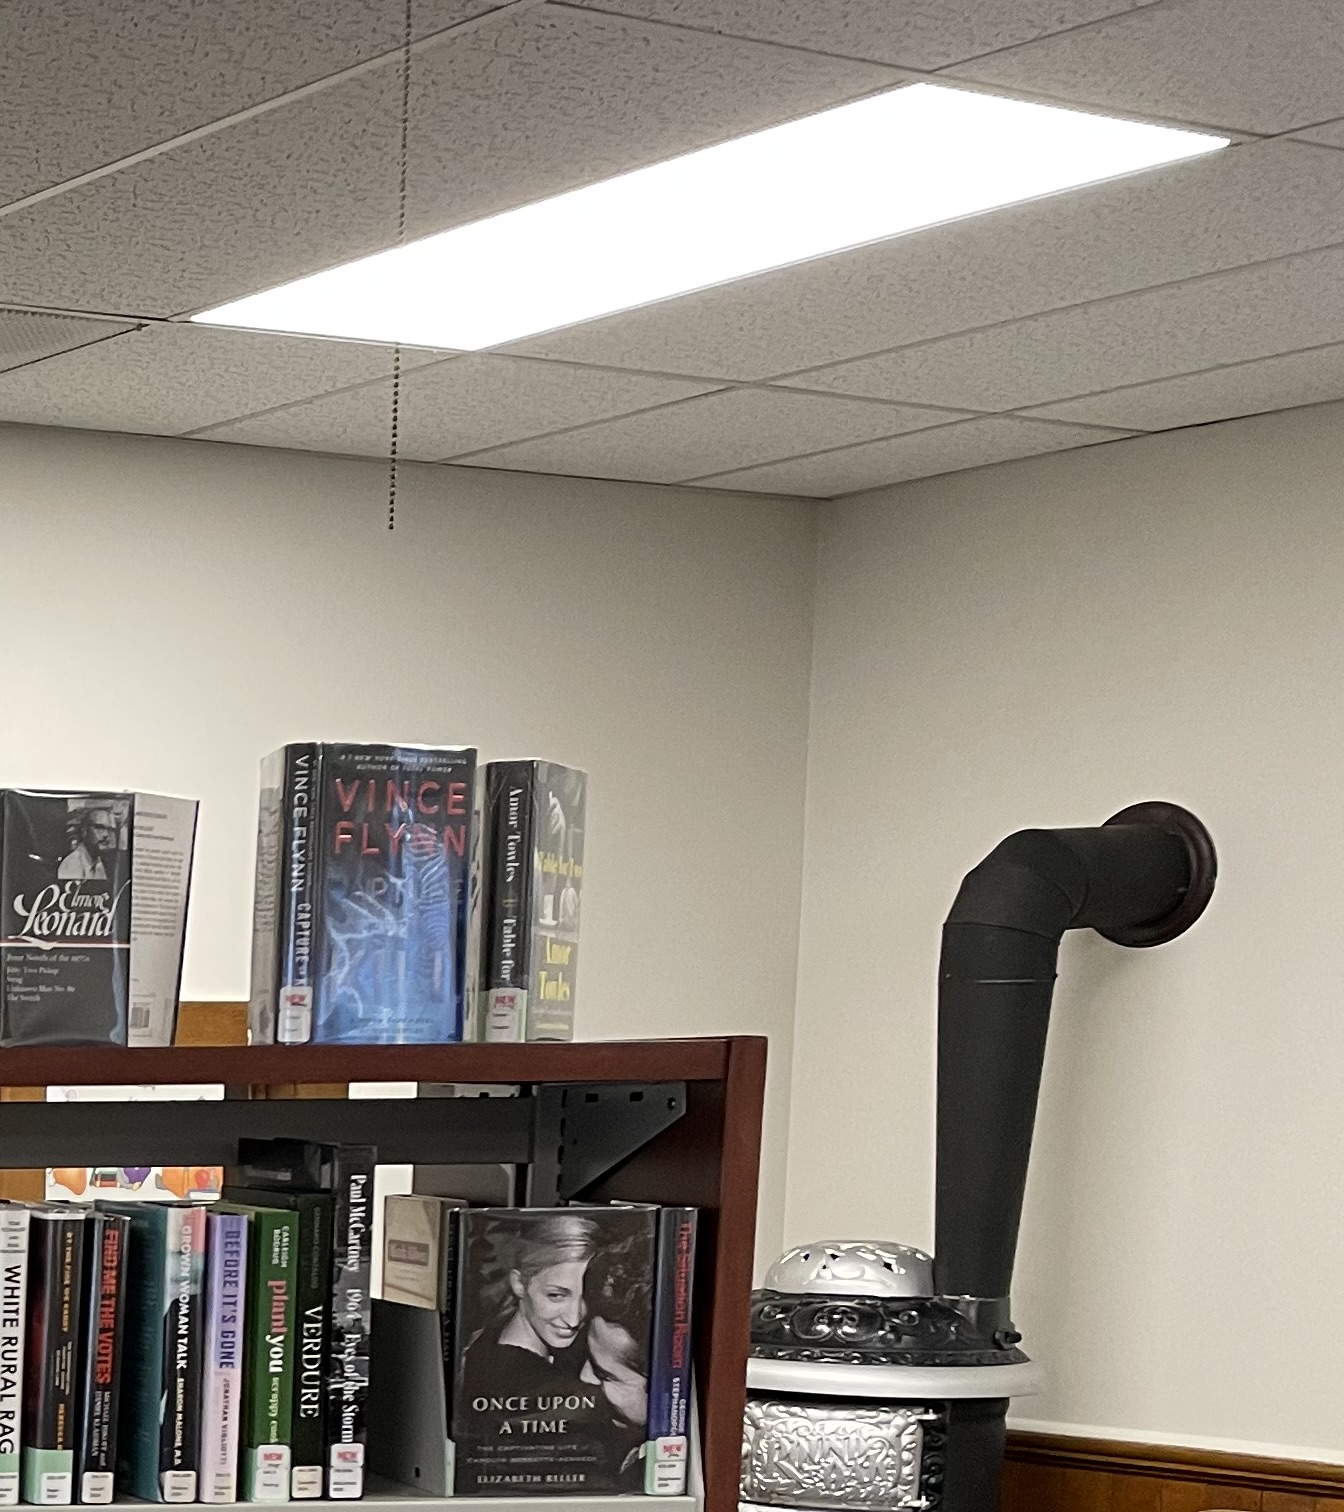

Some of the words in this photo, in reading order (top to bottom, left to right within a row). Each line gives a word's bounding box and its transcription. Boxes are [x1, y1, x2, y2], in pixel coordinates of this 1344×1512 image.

[293, 754, 310, 819] VINCE
[334, 779, 467, 815] VINCE
[290, 827, 308, 892] FLYNN
[3, 1264, 22, 1329] WHITE
[177, 1280, 192, 1335] WOMAN
[0, 1336, 20, 1403] RURAL
[175, 1337, 189, 1370] TALK
[299, 1304, 324, 1419] VERDURE
[472, 1396, 529, 1411] ONCE
[538, 1395, 596, 1410] UPON
[499, 1421, 513, 1434] A
[520, 1419, 568, 1434] TIME
